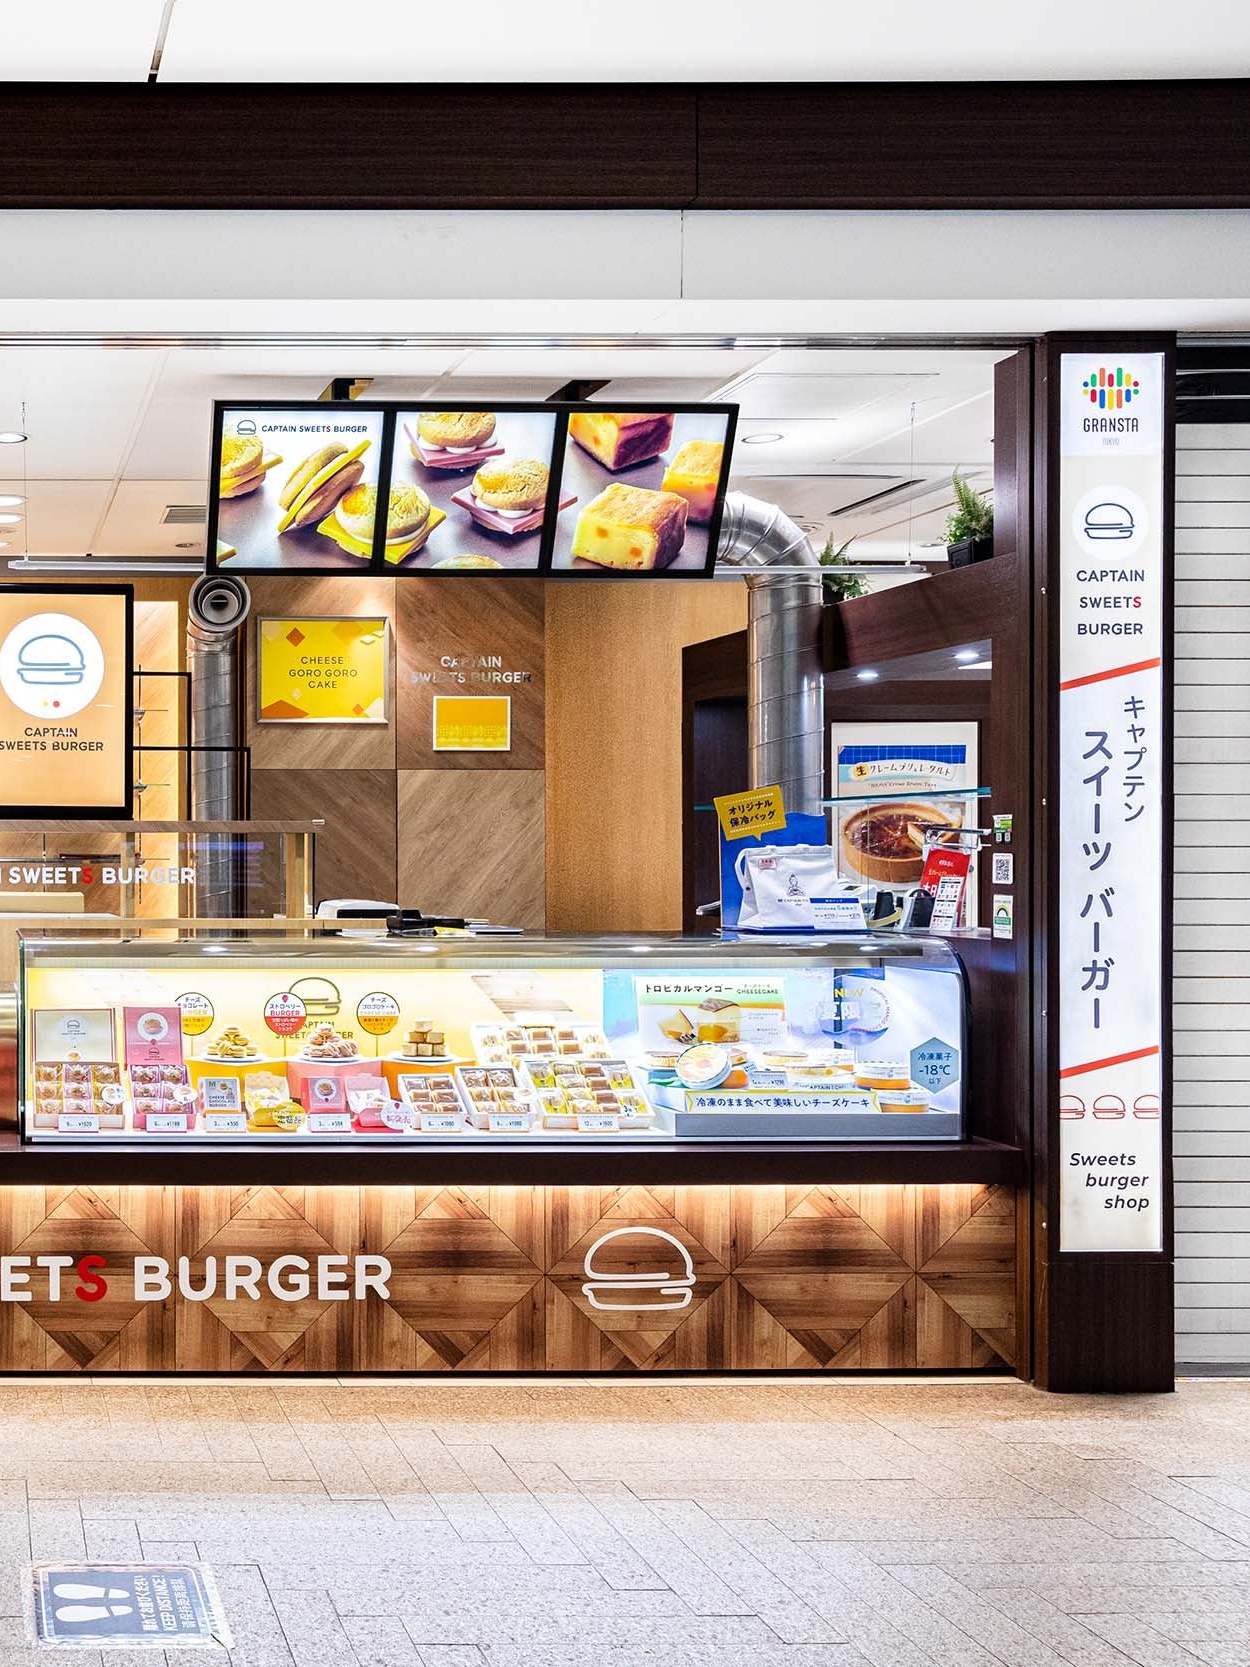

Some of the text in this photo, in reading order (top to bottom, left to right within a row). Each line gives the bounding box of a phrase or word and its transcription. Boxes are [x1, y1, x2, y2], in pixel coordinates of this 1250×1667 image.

[262, 425, 368, 433] CAPTAIN SWEETS BURGER
[1083, 418, 1139, 432] GRANSTA
[1076, 570, 1145, 582] CAPTAIN
[1080, 597, 1142, 608] SWEETS
[1077, 623, 1143, 635] BURGER
[301, 656, 344, 665] CHEESE
[441, 656, 502, 667] CAPTAIN
[289, 669, 358, 678] GORO GORO
[471, 672, 532, 683] BURGER
[308, 681, 337, 689] CAKE
[24, 727, 78, 738] CAPTAIN
[52, 740, 104, 751] BURGER
[1123, 696, 1147, 822] キャプテン
[856, 766, 867, 777] 生
[729, 800, 773, 815] オリジナル
[730, 809, 776, 827] 保冷バッグ
[8, 867, 94, 884] SWEETS
[102, 867, 195, 884] BURGER
[646, 984, 733, 993] トロピカルマンゴー
[918, 1052, 952, 1061] 冷凍菓子
[696, 1097, 870, 1108] 冷凍のまま食べて美味しいチーズケーキ
[1070, 1153, 1136, 1166] Sweets
[1086, 1173, 1149, 1190] burger
[1104, 1195, 1150, 1212] shop
[133, 1254, 392, 1302] BURGER
[159, 1612, 177, 1630] KEEP
